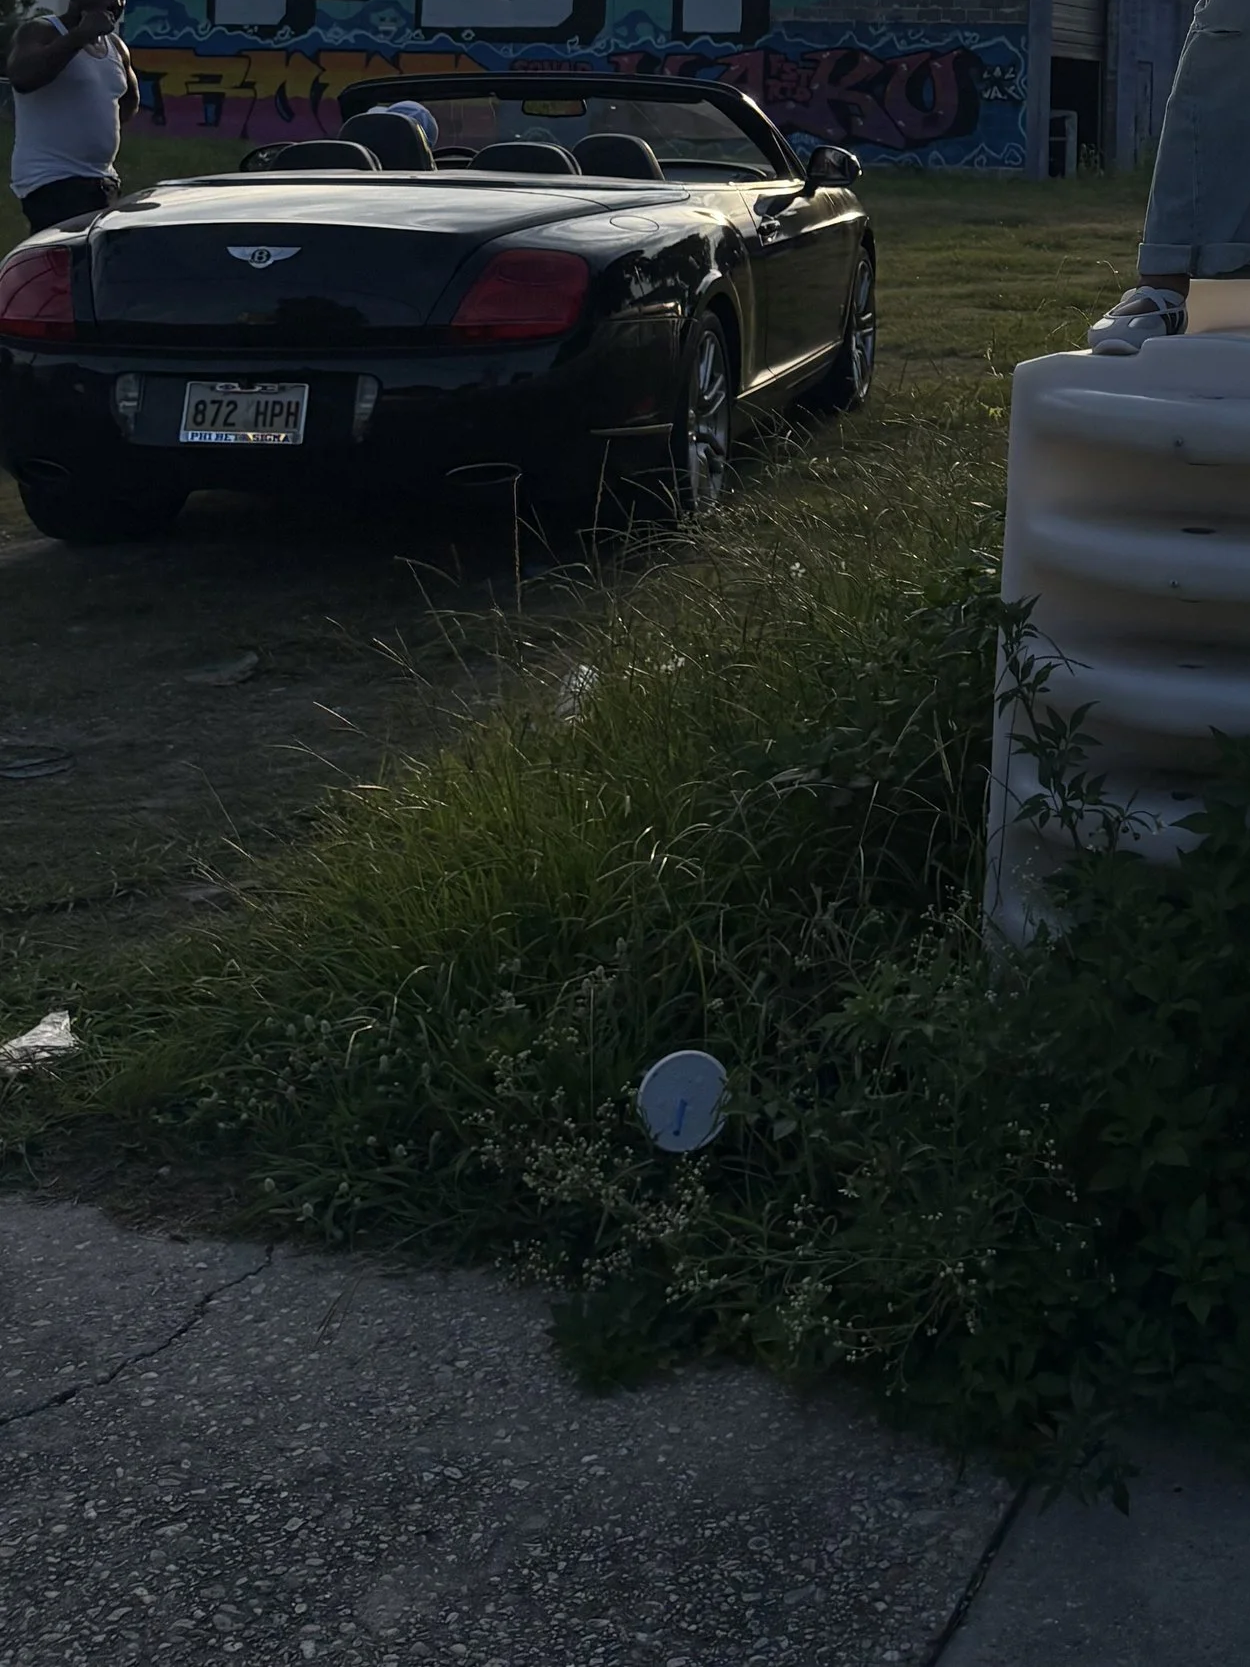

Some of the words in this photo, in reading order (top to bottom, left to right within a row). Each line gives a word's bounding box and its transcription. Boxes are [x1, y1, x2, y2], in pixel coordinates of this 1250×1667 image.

[193, 400, 238, 427] 872
[254, 400, 300, 428] HPH
[252, 434, 290, 443] SIGMA
